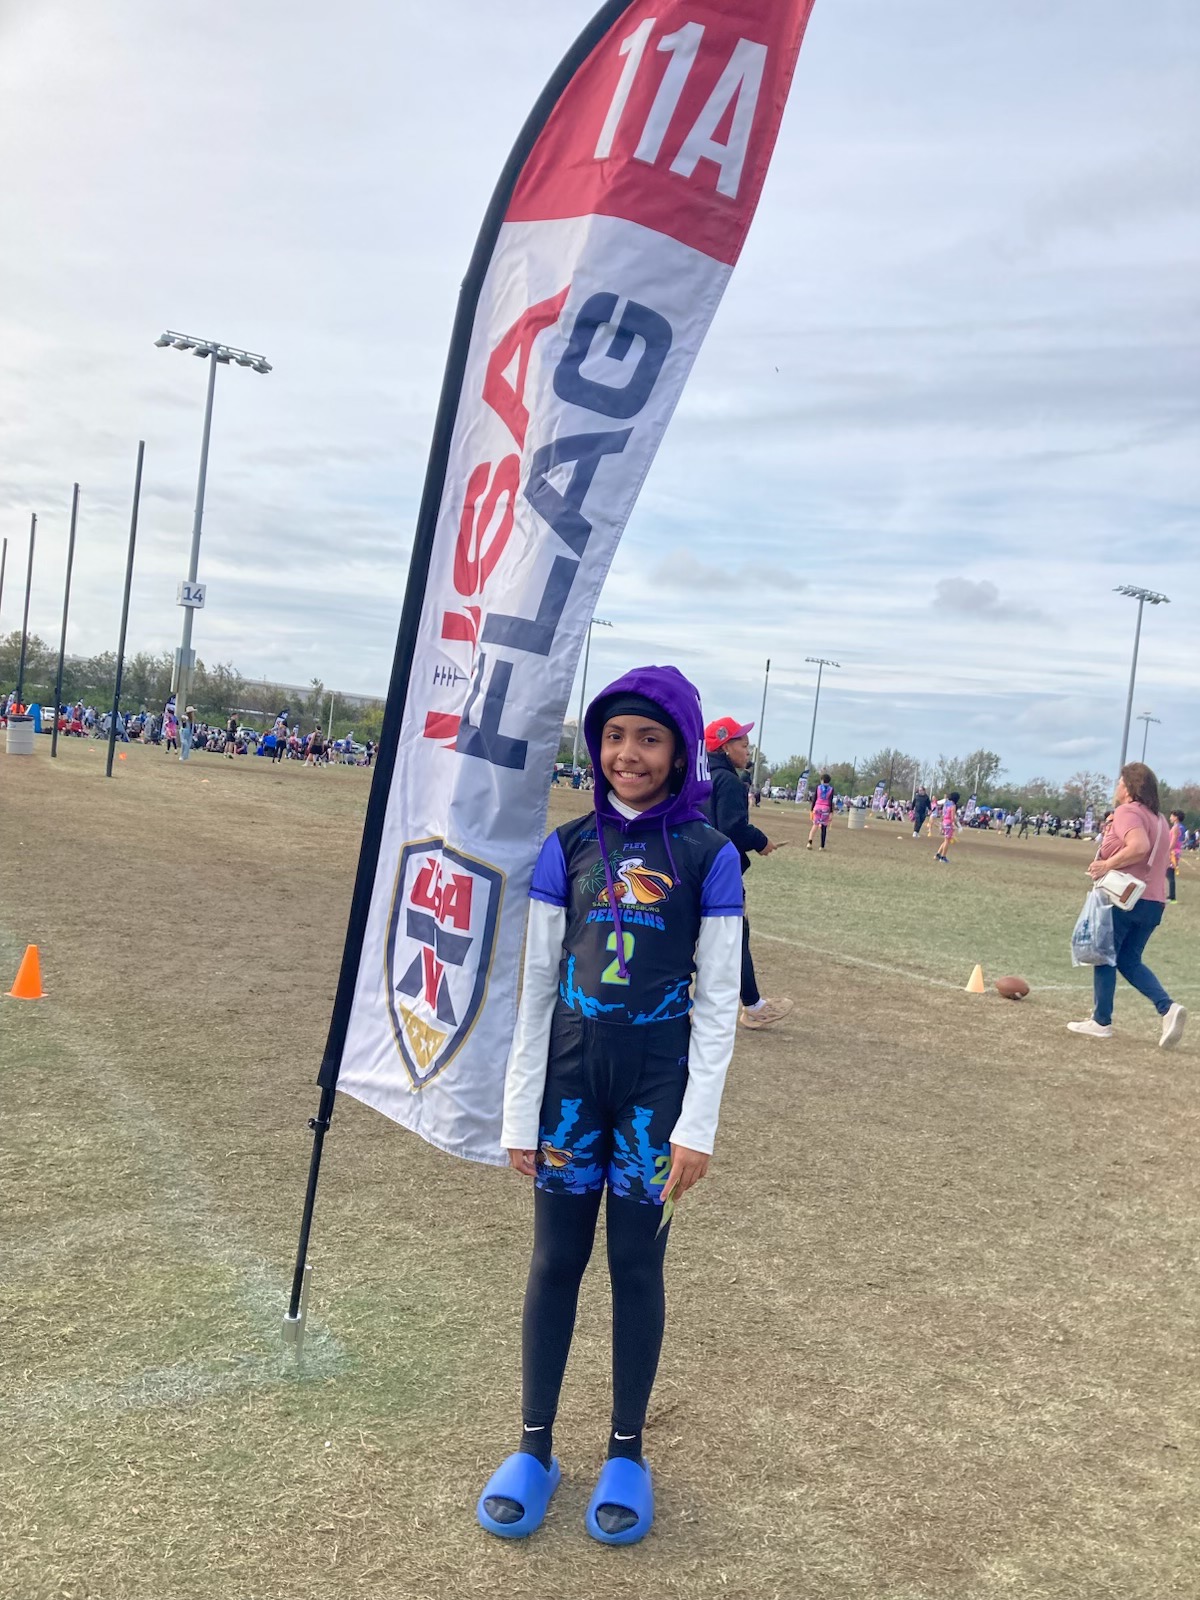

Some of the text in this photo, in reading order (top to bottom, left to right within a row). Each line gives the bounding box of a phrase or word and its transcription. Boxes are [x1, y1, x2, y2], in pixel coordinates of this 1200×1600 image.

[593, 16, 768, 200] 11A
[455, 291, 673, 771] FLAG
[183, 586, 203, 603] 14
[622, 842, 647, 852] FLEX
[616, 903, 661, 913] ETERSBURG
[600, 930, 636, 987] 2
[649, 1156, 671, 1185] 2
